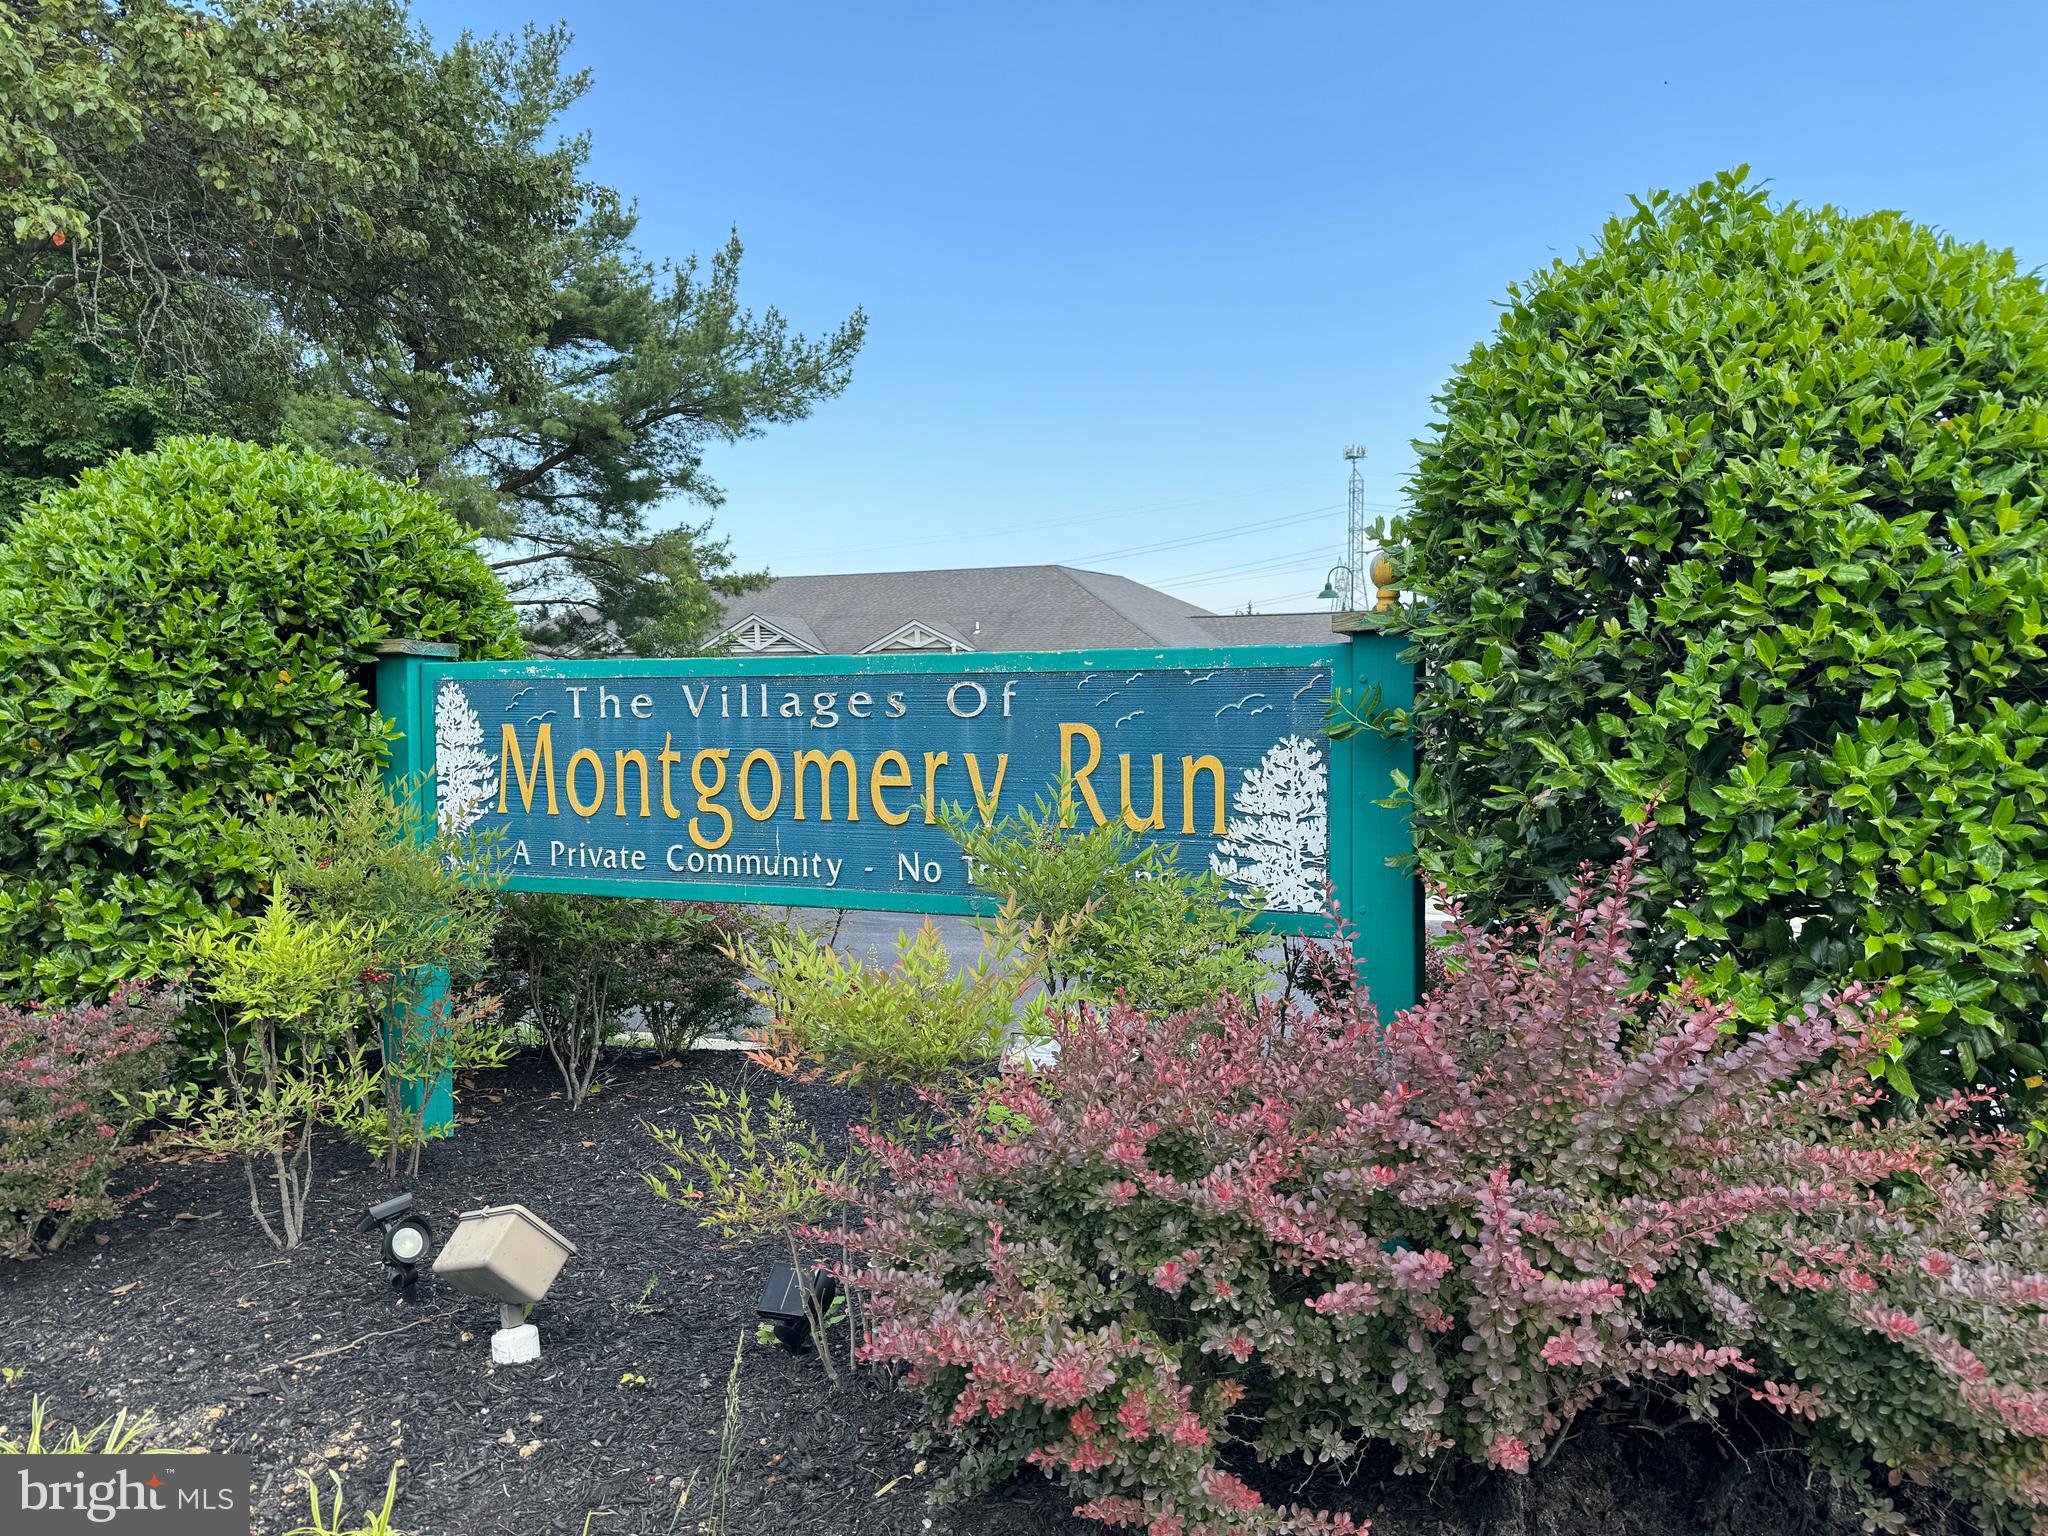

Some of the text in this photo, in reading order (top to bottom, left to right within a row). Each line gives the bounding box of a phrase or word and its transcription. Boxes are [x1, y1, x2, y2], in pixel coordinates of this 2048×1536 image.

[565, 680, 1019, 729] The Villages Of
[1058, 722, 1228, 835] Run
[513, 840, 531, 865] A
[551, 840, 646, 870] Private
[666, 844, 842, 887] Community
[898, 851, 942, 883] No
